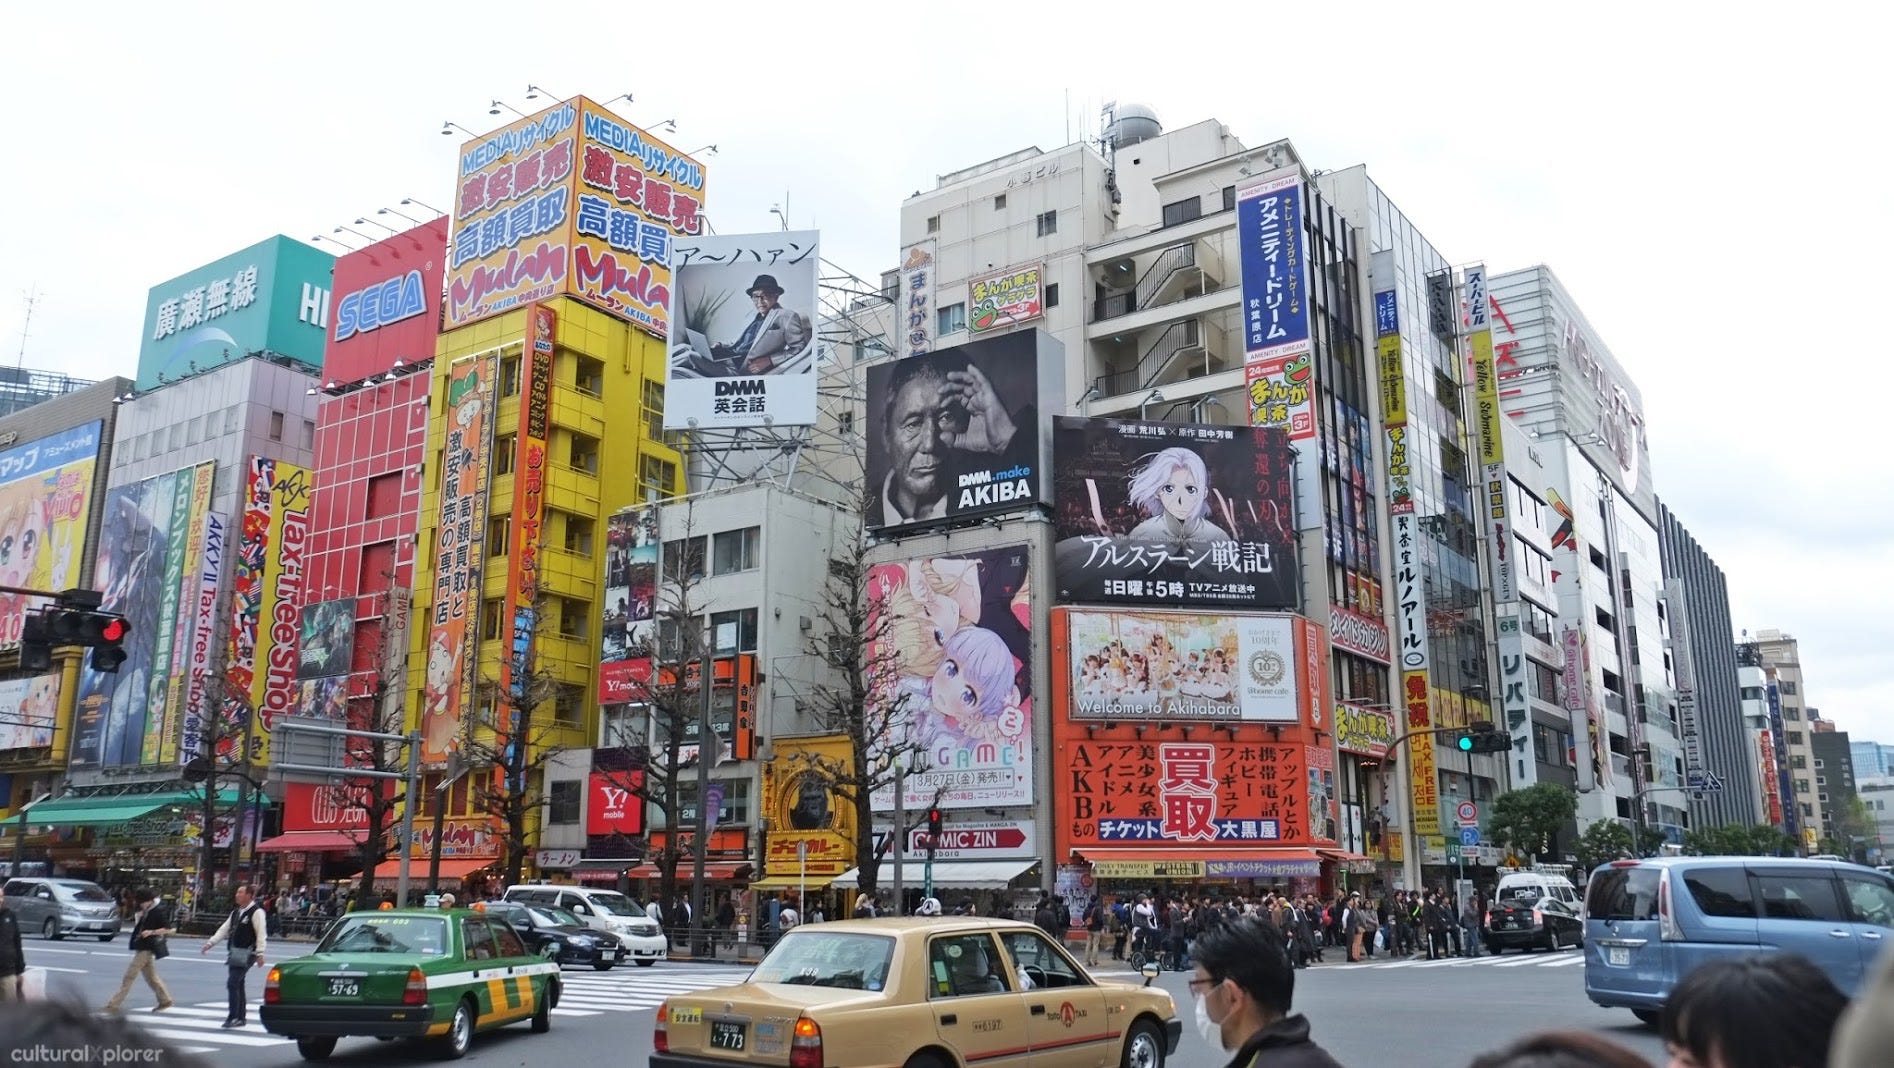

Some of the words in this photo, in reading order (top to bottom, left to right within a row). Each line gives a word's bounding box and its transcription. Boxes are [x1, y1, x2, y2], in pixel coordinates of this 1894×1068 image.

[462, 104, 576, 177] MEDIAリサイクル
[584, 111, 703, 190] MEDIAリサイクル
[583, 146, 700, 233] 激安販売
[453, 186, 567, 268] 高額買取
[577, 193, 671, 268] 高額買
[335, 269, 428, 342] SEGA
[451, 244, 566, 321] Mulan
[491, 295, 517, 310] AKIBA
[586, 288, 624, 313] ムーラン
[624, 306, 651, 324] AKIBA
[534, 351, 550, 364] DVD
[714, 396, 765, 414] 英会話
[715, 379, 766, 396] DMM
[1250, 377, 1308, 405] まんが
[958, 478, 1032, 509] AKIBA
[203, 514, 224, 568] AKKY
[1080, 534, 1273, 575] アルスラーン戦記
[194, 587, 217, 663] Tax-free
[395, 592, 409, 631] GAME
[1077, 699, 1144, 716] Welcome
[1148, 702, 1162, 715] to
[1167, 701, 1241, 716] Akihabara
[1405, 675, 1430, 728] 免税
[1097, 744, 1116, 815] アイドル
[1117, 744, 1136, 797] アニメ
[1136, 745, 1157, 818] 美少女系
[1160, 745, 1216, 840] 買取
[1220, 746, 1240, 818] フィギュア
[1239, 746, 1256, 798] ホビー
[1258, 746, 1280, 818] 携帯電話
[1280, 747, 1301, 841] アップルとか
[1424, 767, 1436, 806] FREE
[601, 786, 628, 809] Y!
[603, 811, 625, 820] mobile
[914, 831, 971, 849] CMIC
[973, 831, 997, 848] ZIN
[1100, 820, 1159, 839] チケット
[1221, 820, 1278, 839] 大黒屋
[542, 852, 576, 865] ラーメン
